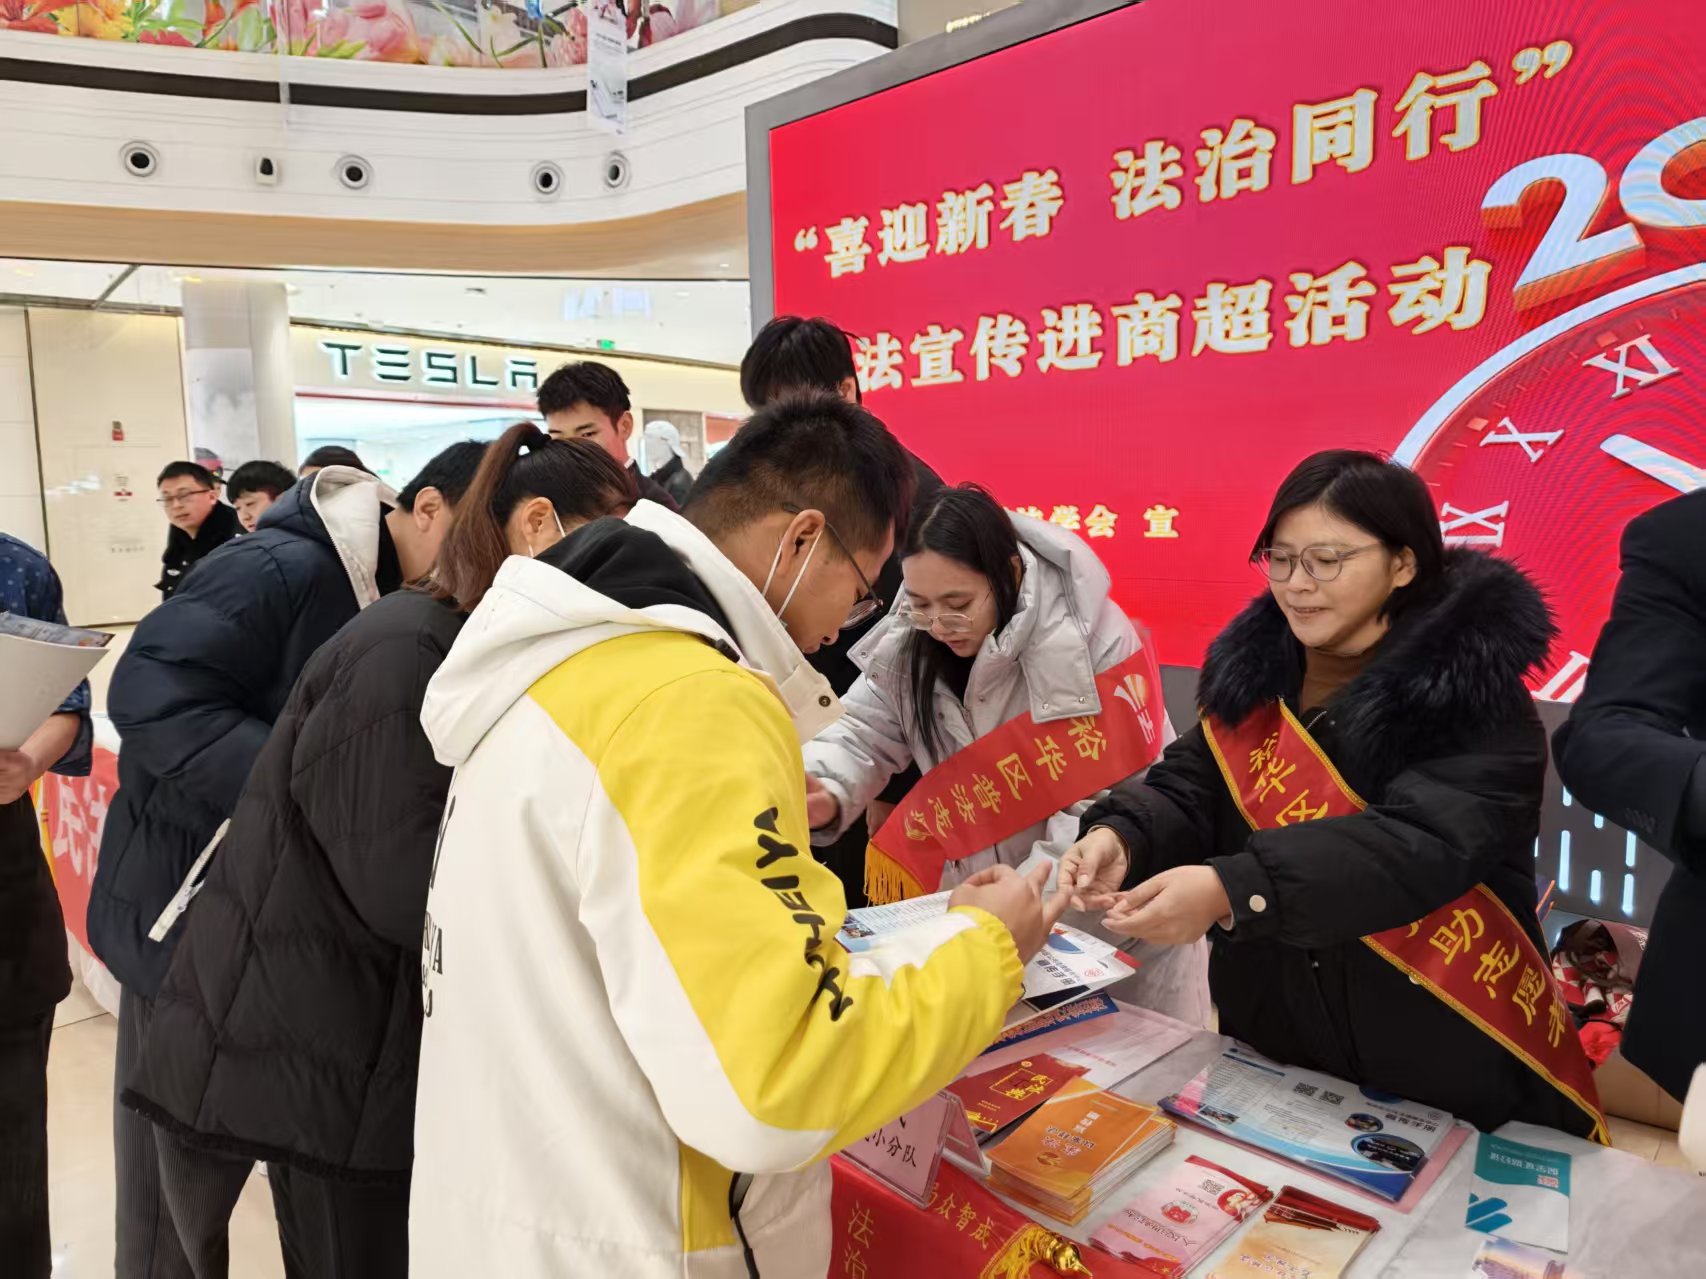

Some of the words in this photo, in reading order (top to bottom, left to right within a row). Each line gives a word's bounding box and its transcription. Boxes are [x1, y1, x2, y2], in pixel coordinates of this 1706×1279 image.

[1110, 40, 1573, 220] 法治同行”
[322, 342, 538, 390] TESLA
[1142, 503, 1180, 538] 宣
[1405, 907, 1568, 1048] 助志愿者
